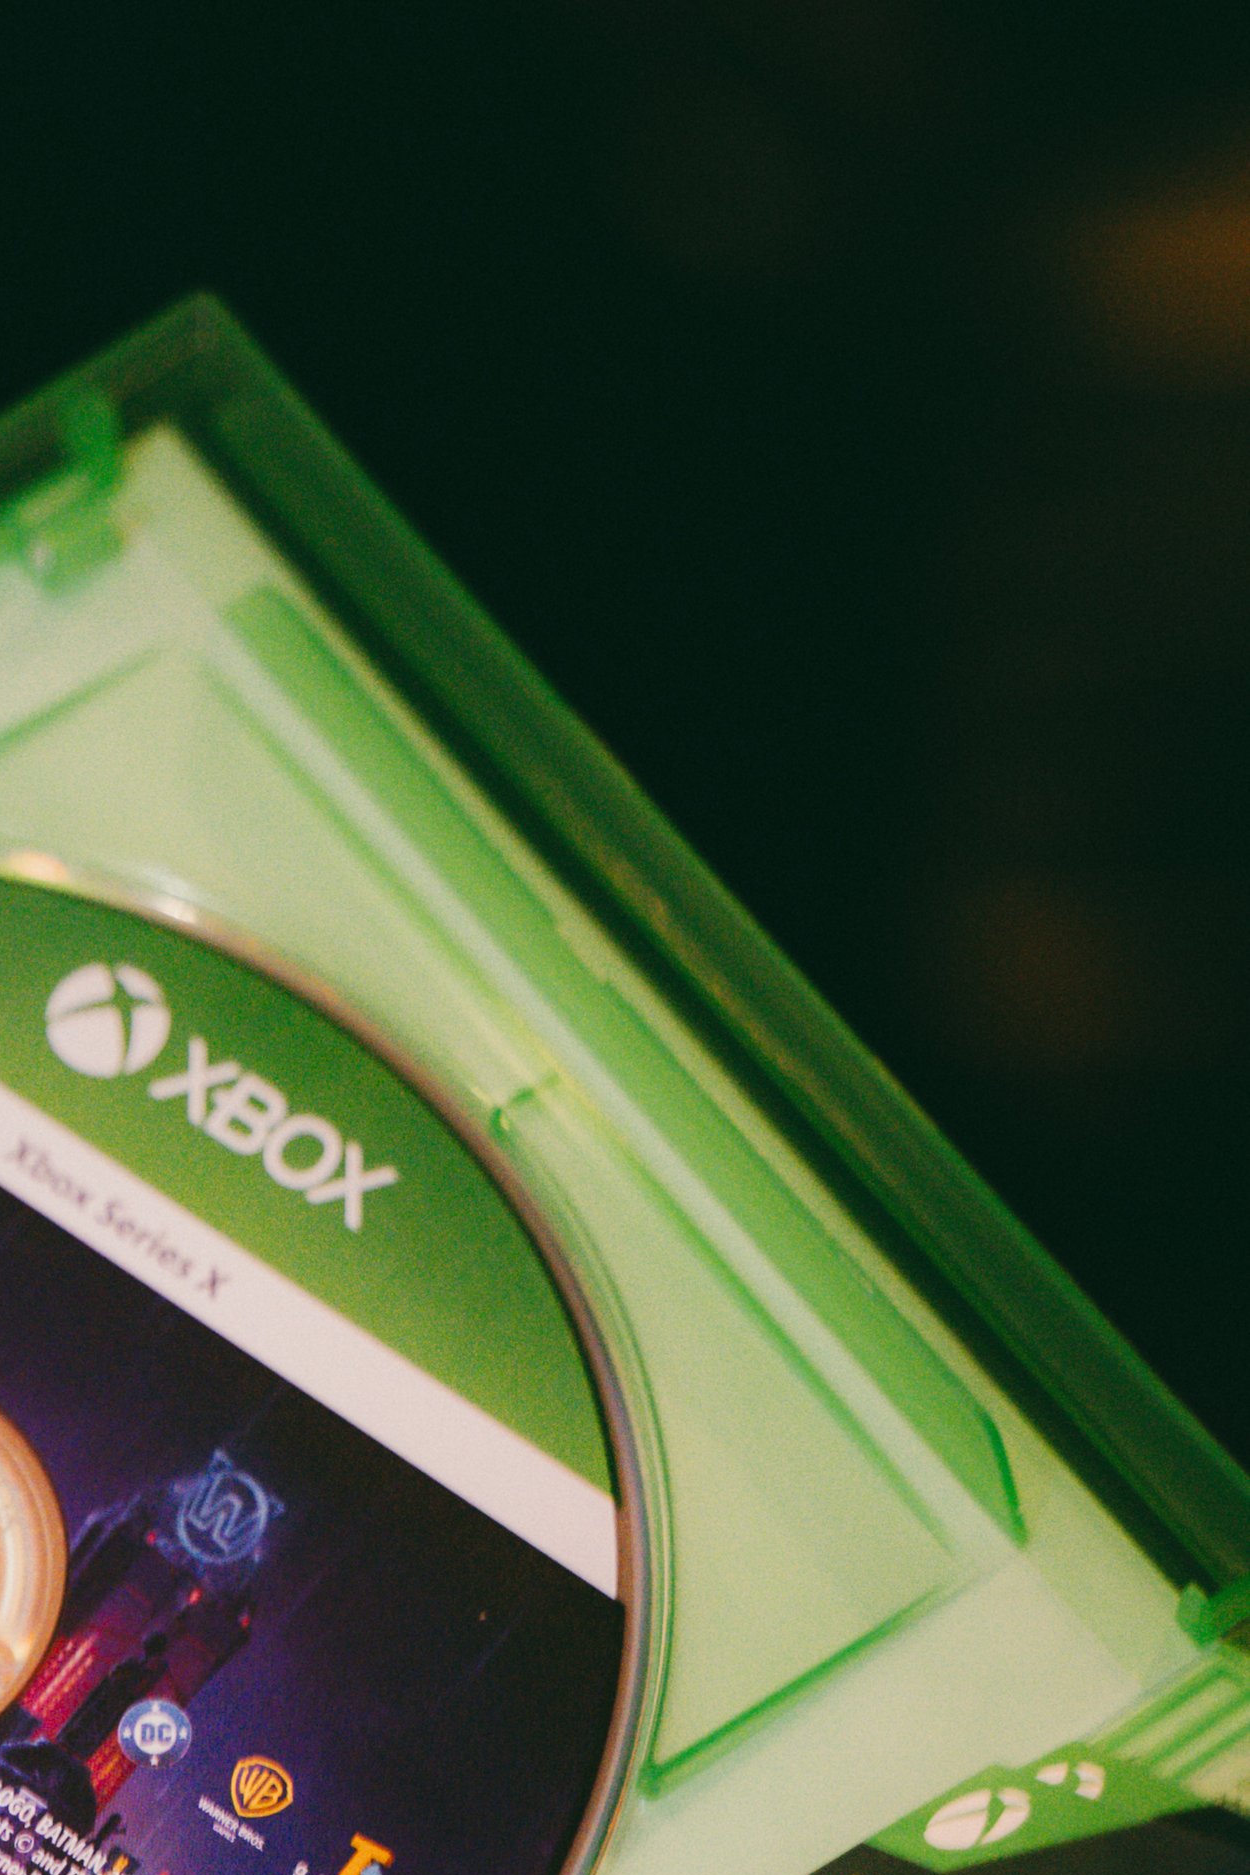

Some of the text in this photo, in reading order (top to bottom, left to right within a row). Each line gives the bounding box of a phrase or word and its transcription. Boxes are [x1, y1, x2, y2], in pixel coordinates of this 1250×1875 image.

[149, 1035, 399, 1232] XBOX
[8, 1138, 230, 1299] Xbox Series X
[198, 1795, 239, 1834] WARNER
